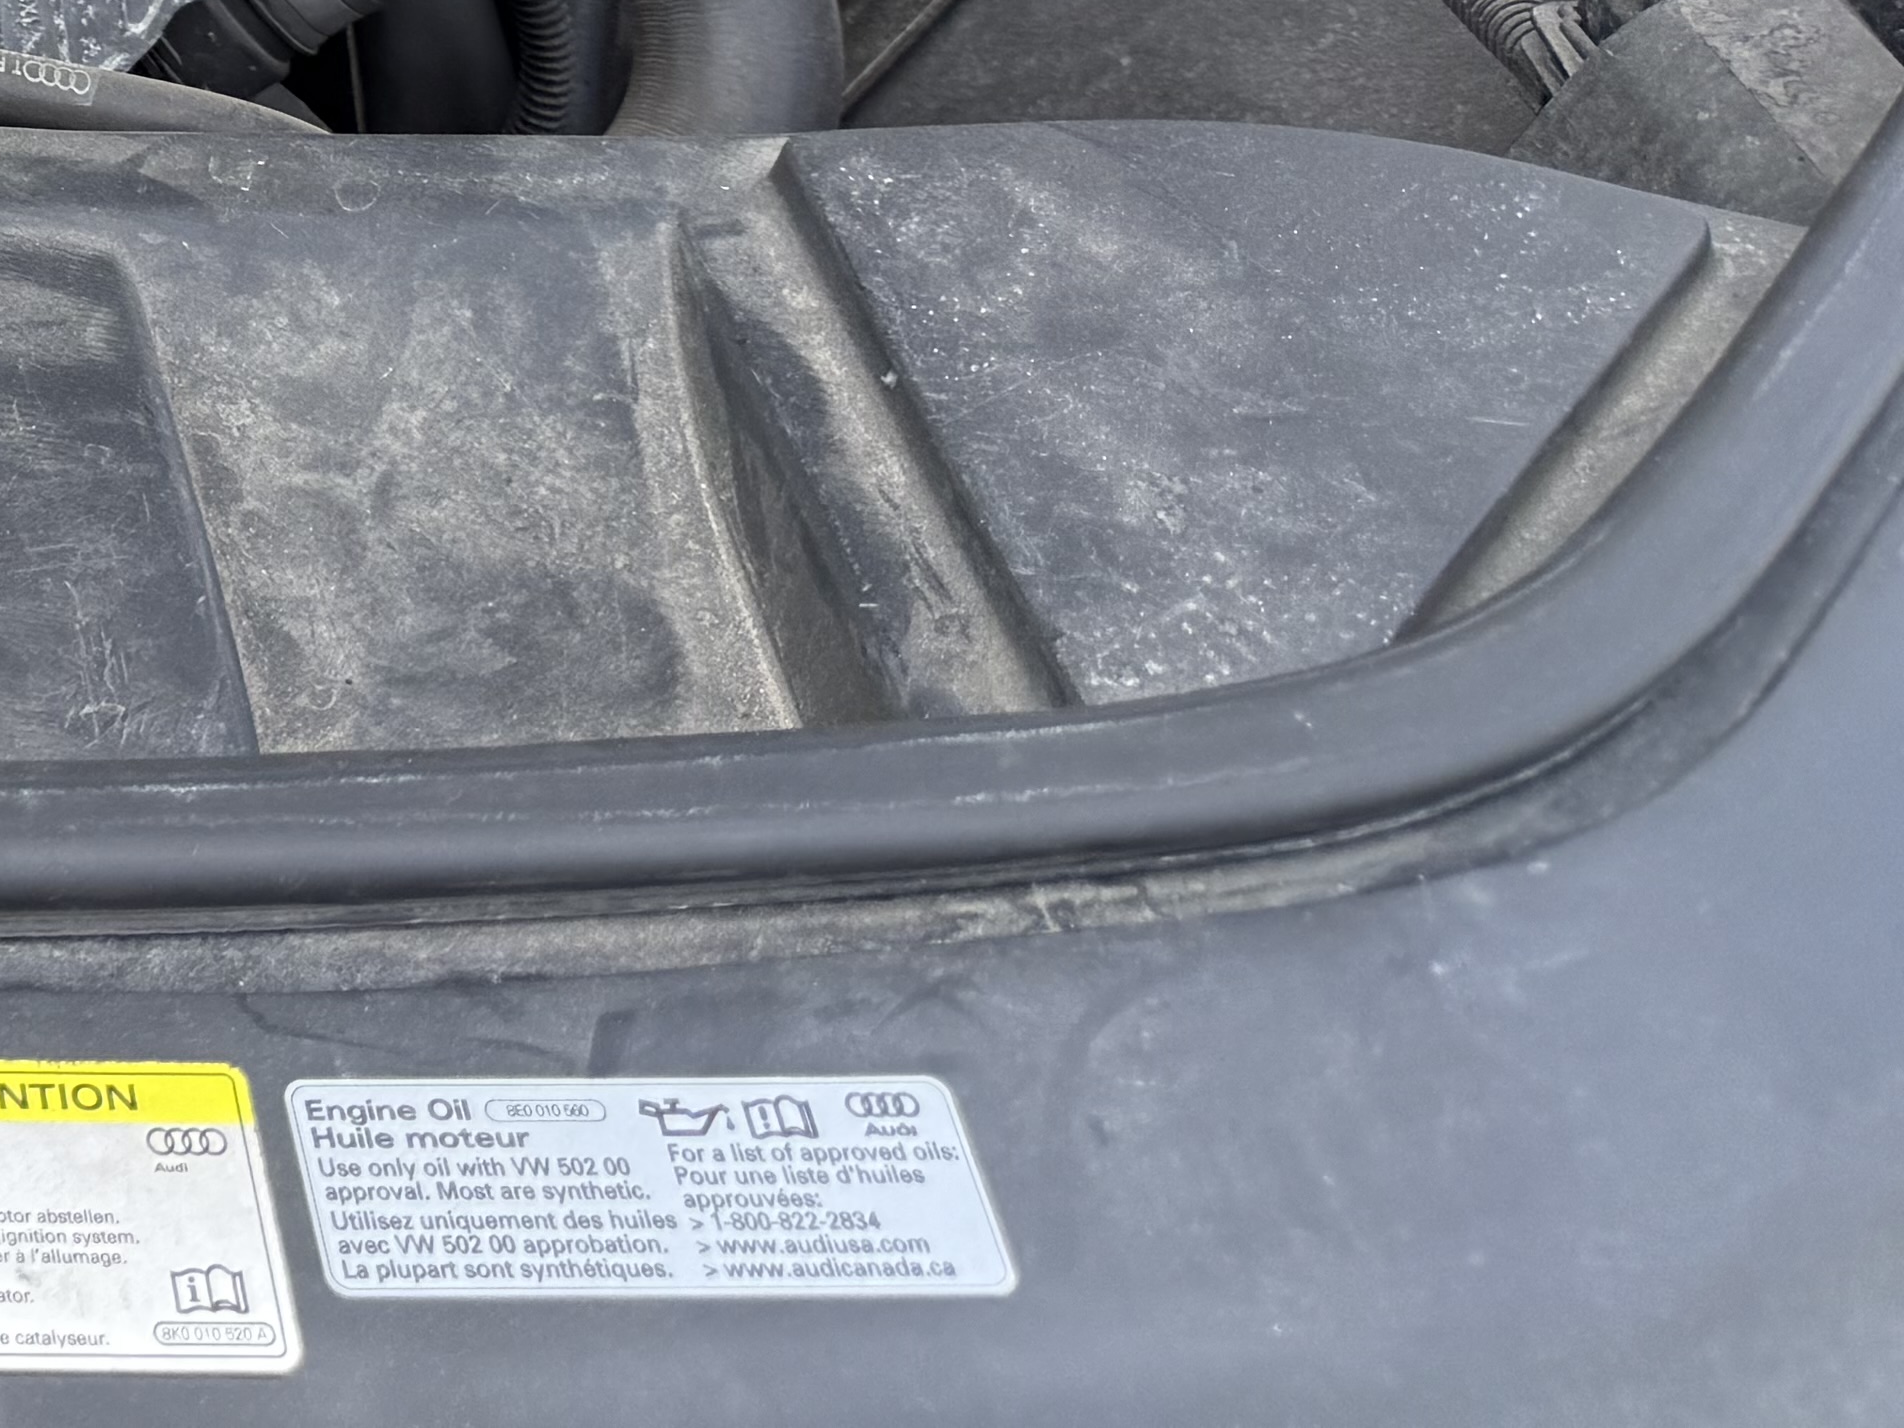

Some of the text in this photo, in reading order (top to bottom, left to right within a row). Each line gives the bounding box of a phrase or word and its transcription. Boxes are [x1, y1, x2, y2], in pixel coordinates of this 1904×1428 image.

[304, 1098, 472, 1126] Engine Oil
[535, 1104, 561, 1117] 010
[310, 1126, 529, 1149] Huile moteur
[864, 1122, 918, 1138] Audi
[667, 1141, 960, 1166] For list of approved oils:
[154, 1162, 188, 1173] Audi
[318, 1157, 631, 1181] Use only oil with VW 502 00
[673, 1164, 926, 1186] Pour une liste d'huiles
[325, 1180, 651, 1205] approval. Most are synthetic.
[683, 1188, 823, 1213] approuvées:
[37, 1209, 120, 1224] abstellen.
[330, 1209, 678, 1233] Utilisez uniquement des huiles
[709, 1211, 882, 1232] 1-800-822-2834
[1, 1228, 67, 1246] ignition
[73, 1230, 140, 1247] system.
[338, 1234, 669, 1258] avec VW 502 00 approbation.
[716, 1234, 931, 1255] www.audiusa.com
[342, 1258, 673, 1283] La plupart sont synthétiques.
[723, 1256, 957, 1278] www.audicanada.ca
[15, 1330, 110, 1348] catalyseur.
[194, 1327, 222, 1341] 010
[226, 1327, 253, 1341] 520
